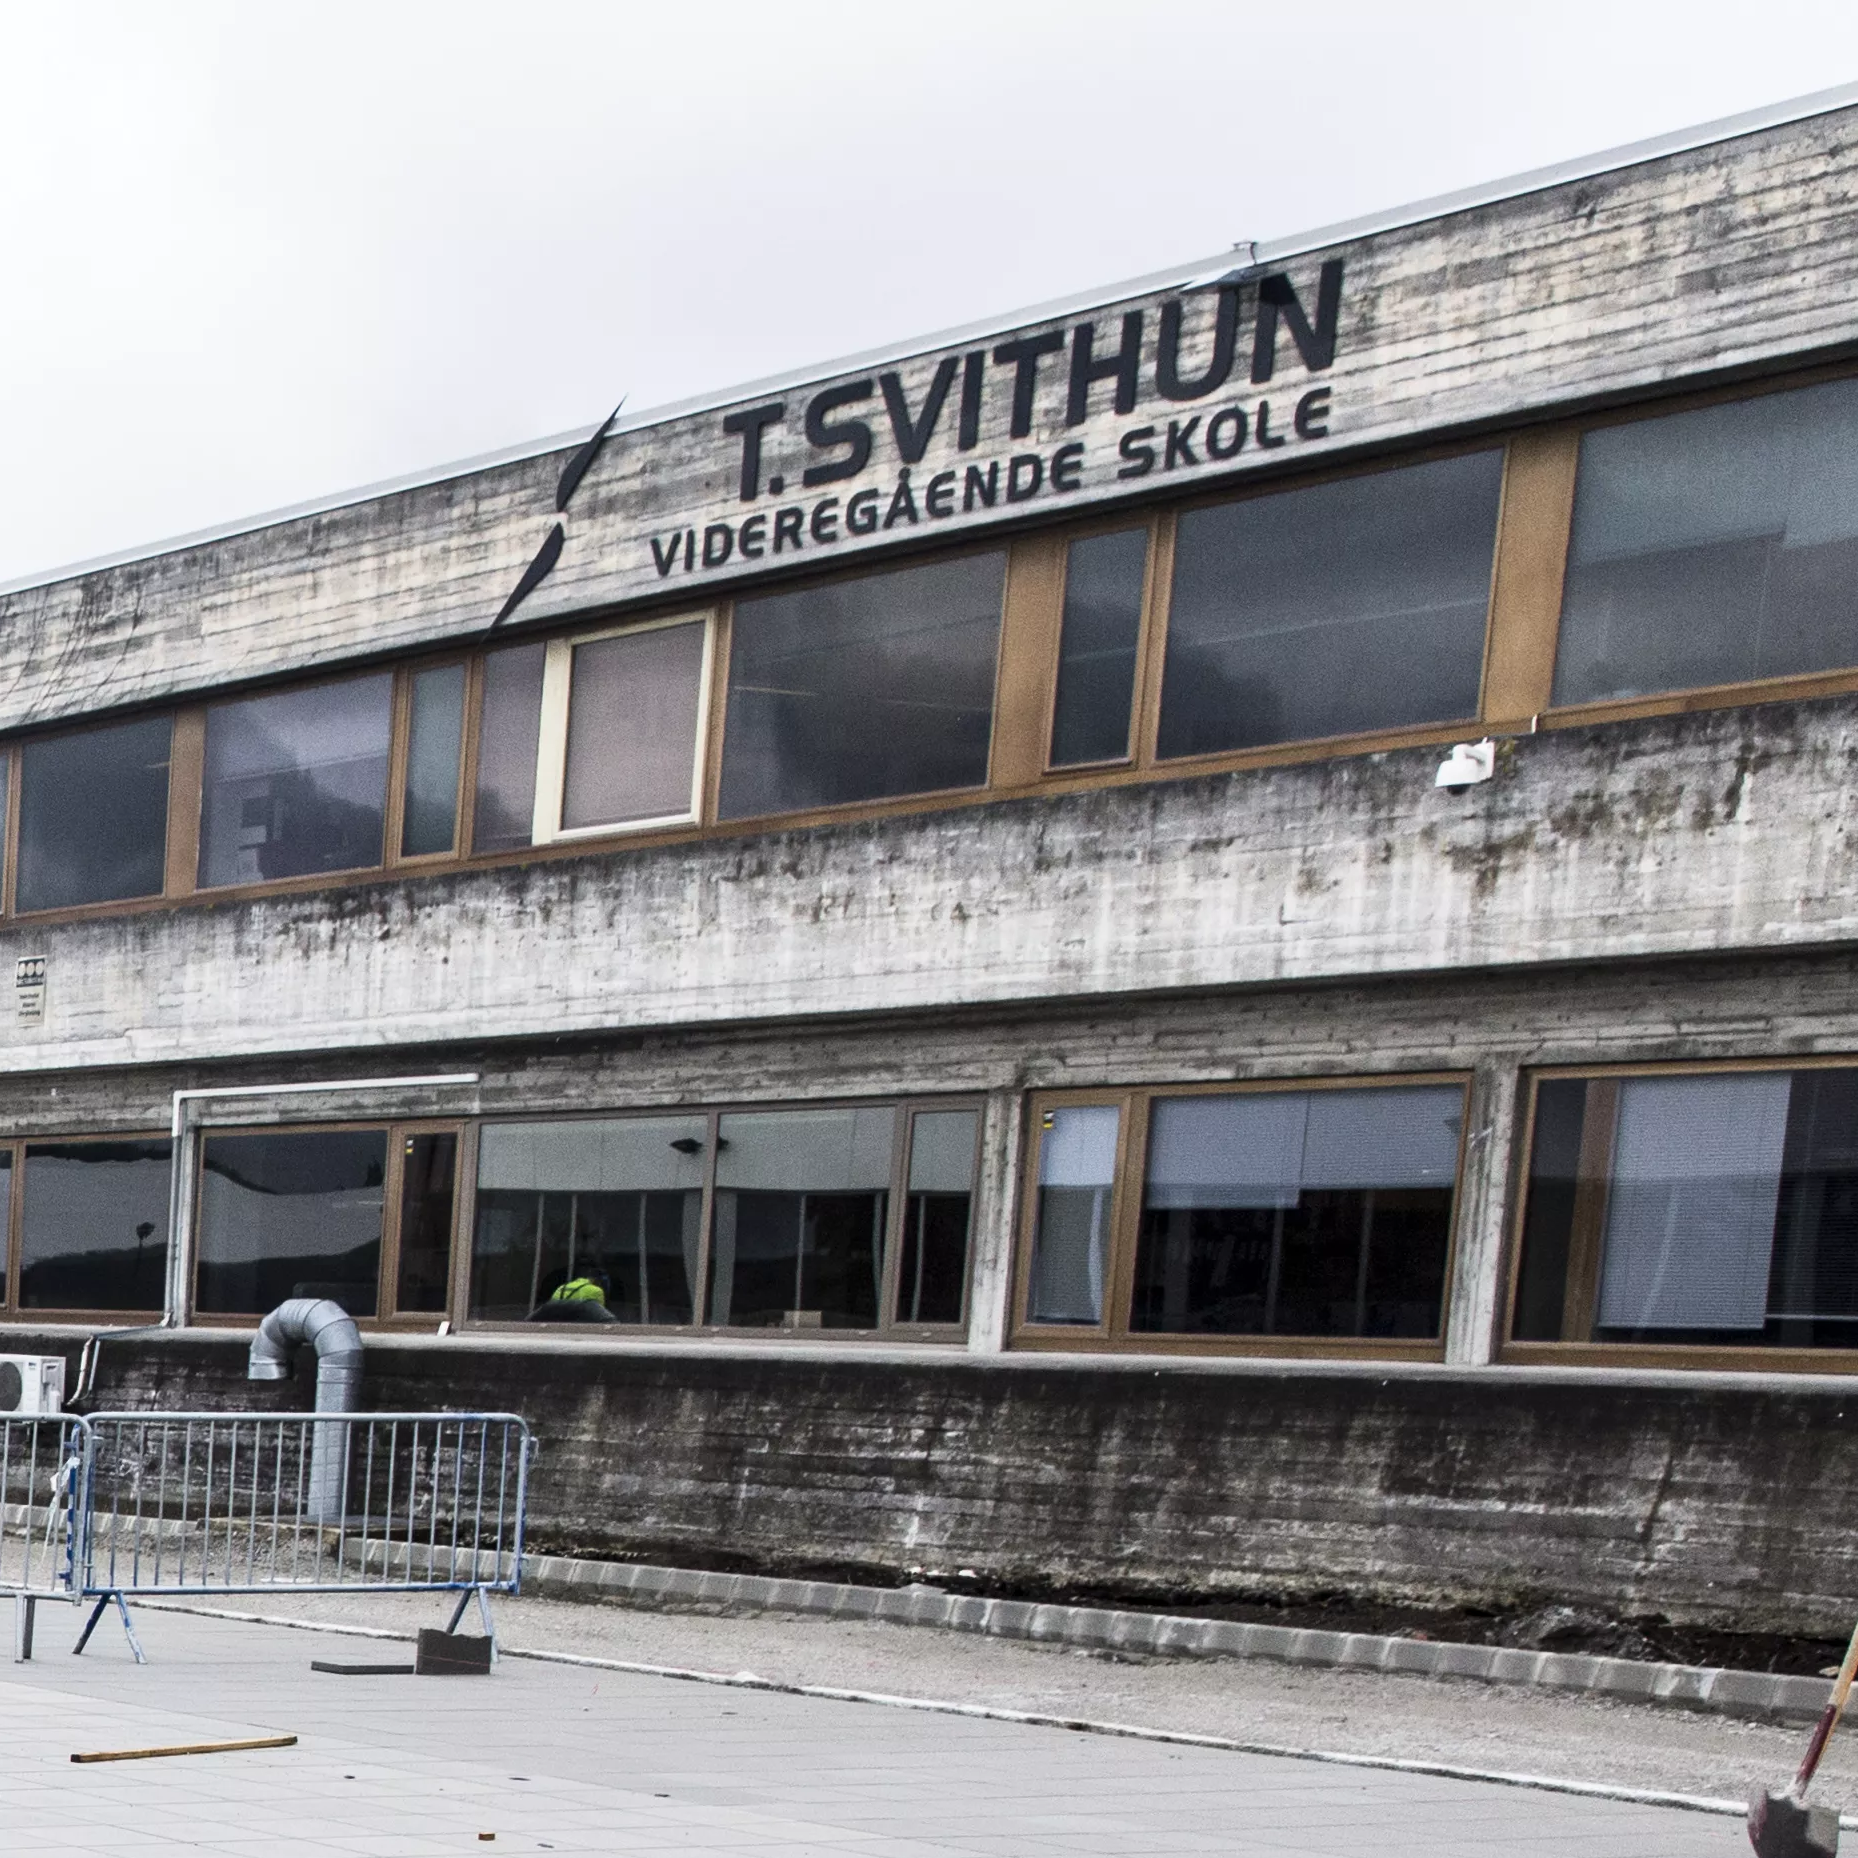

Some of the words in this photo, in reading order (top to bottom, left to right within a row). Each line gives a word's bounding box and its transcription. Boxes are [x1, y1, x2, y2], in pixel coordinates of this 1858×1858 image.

[650, 440, 1082, 577] VIDEREGÅENDE
[1117, 387, 1332, 479] SKOLE
[723, 259, 1344, 501] T.SVITHUN
